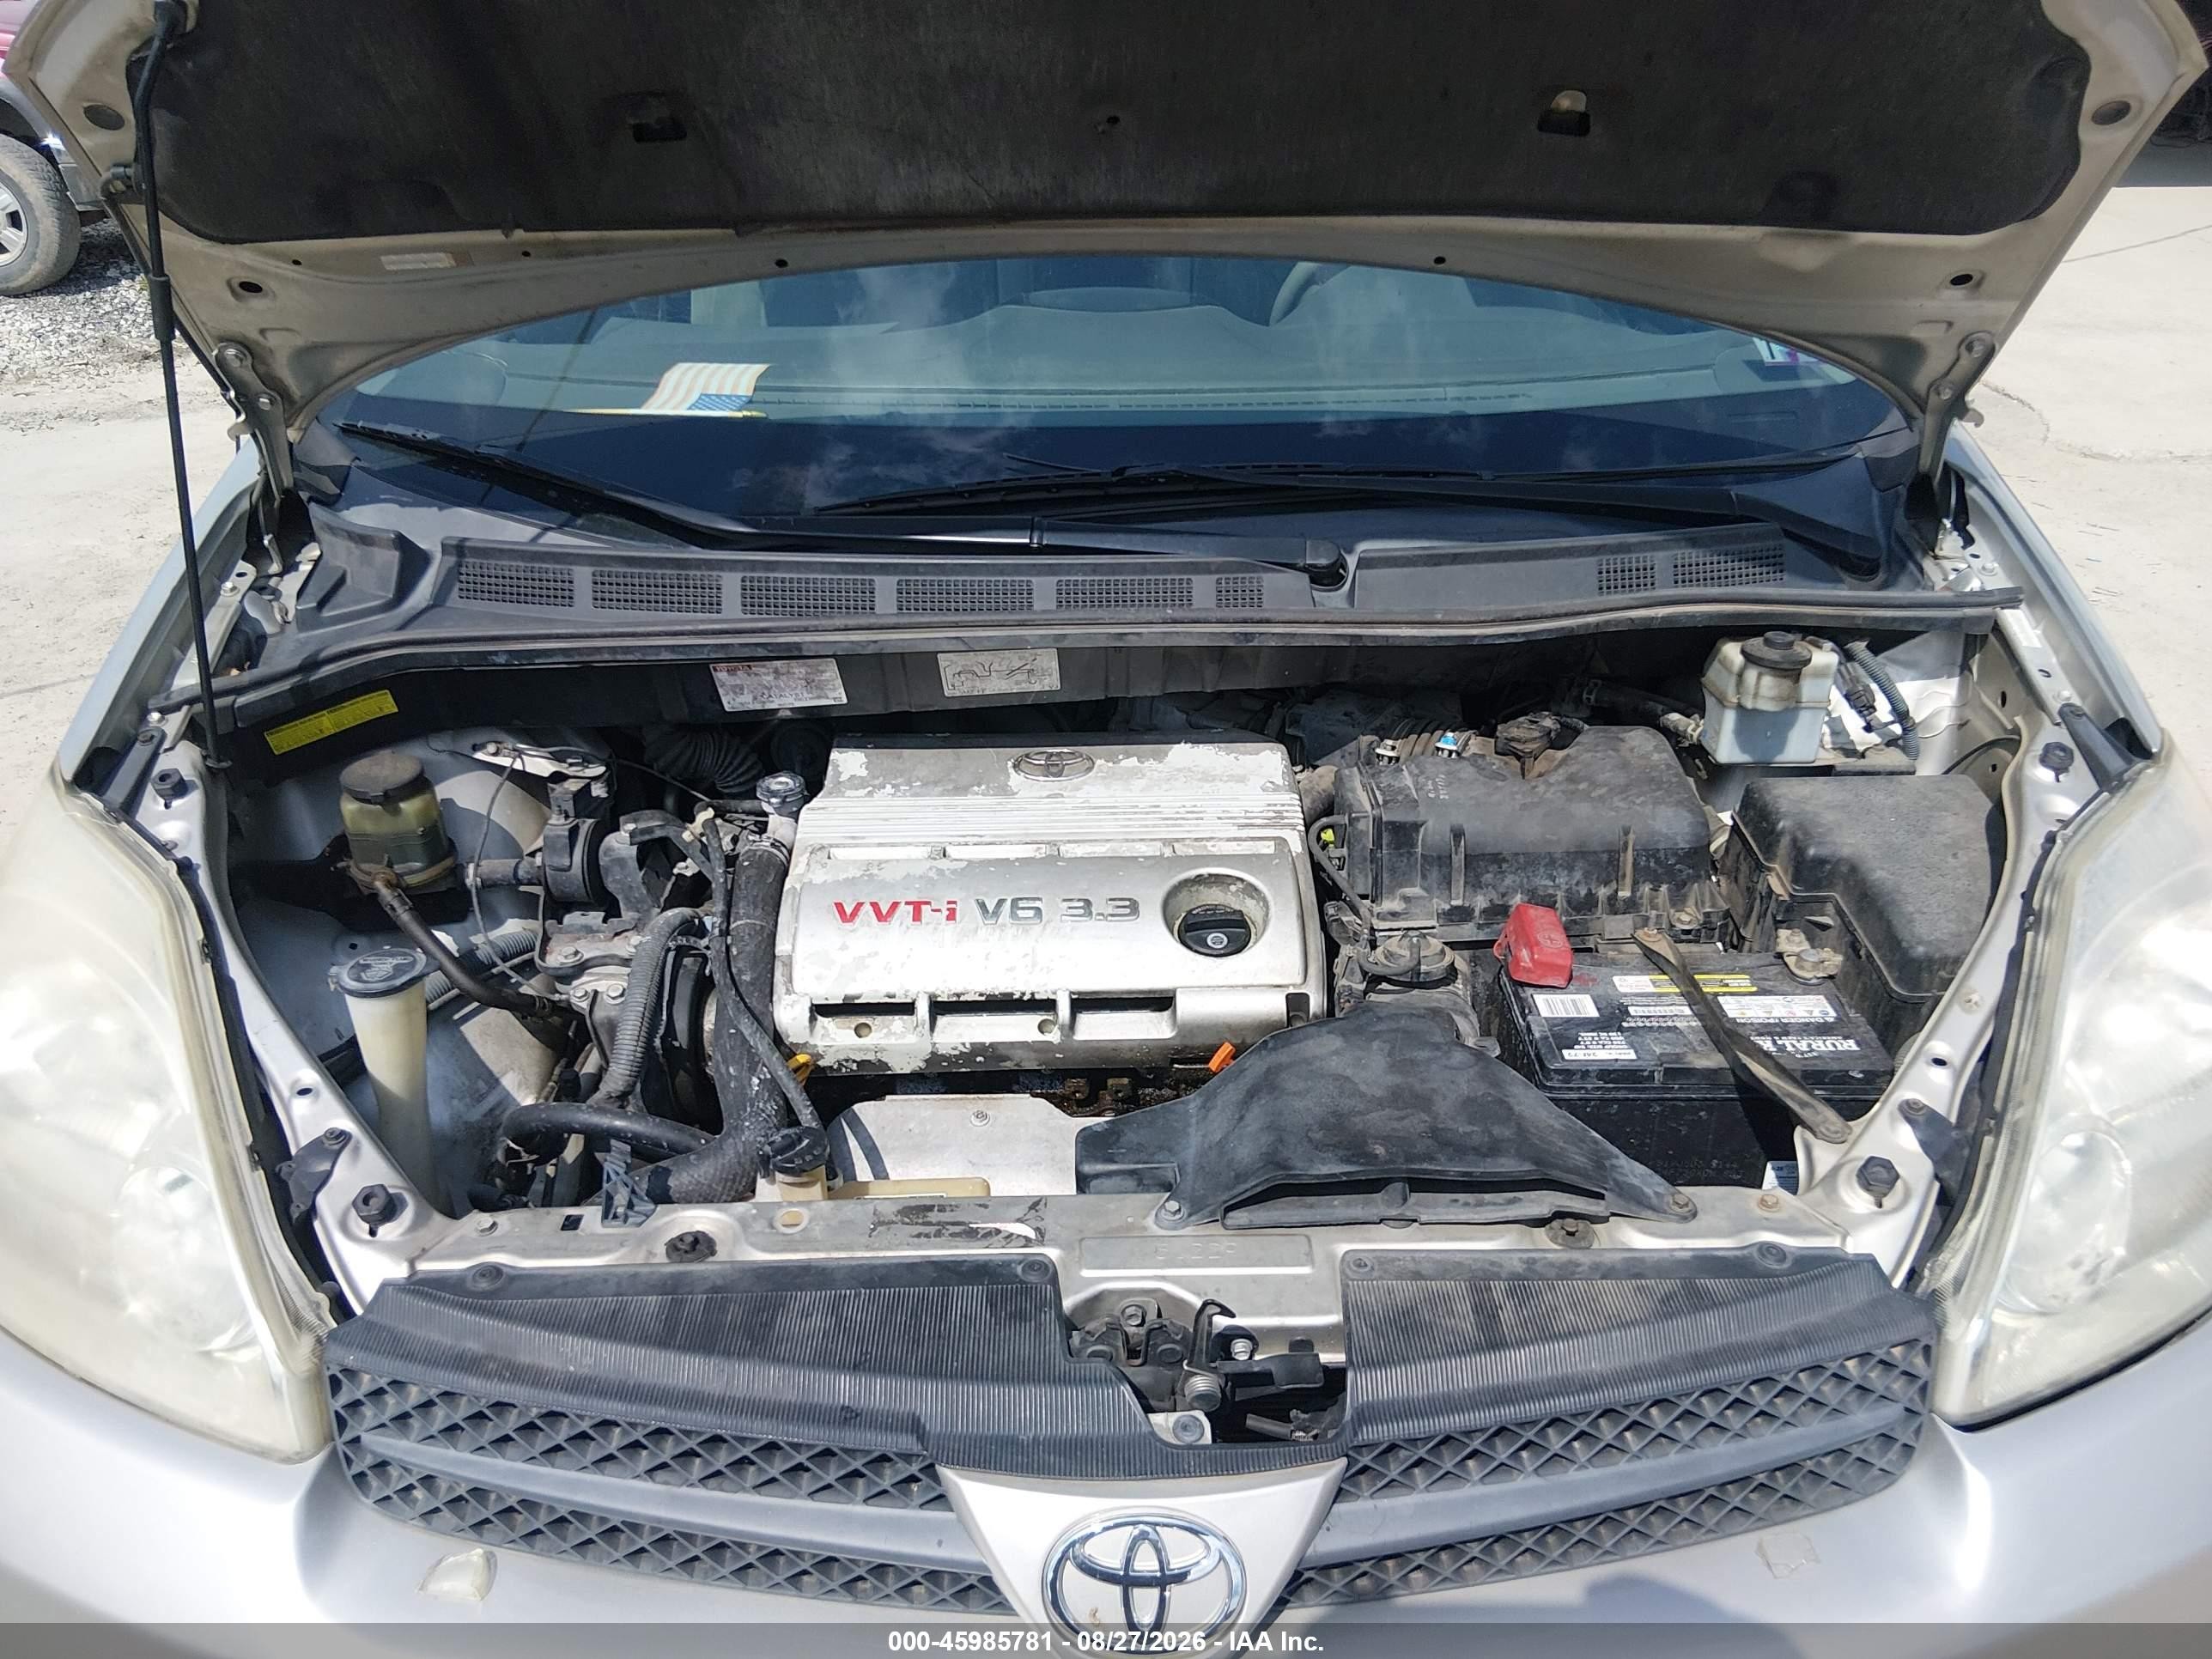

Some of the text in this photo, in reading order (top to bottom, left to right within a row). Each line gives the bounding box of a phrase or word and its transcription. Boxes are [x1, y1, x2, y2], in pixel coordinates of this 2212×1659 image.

[833, 896, 1140, 926] VVT-i V6 3.3
[1777, 1039, 1861, 1050] RURAL
